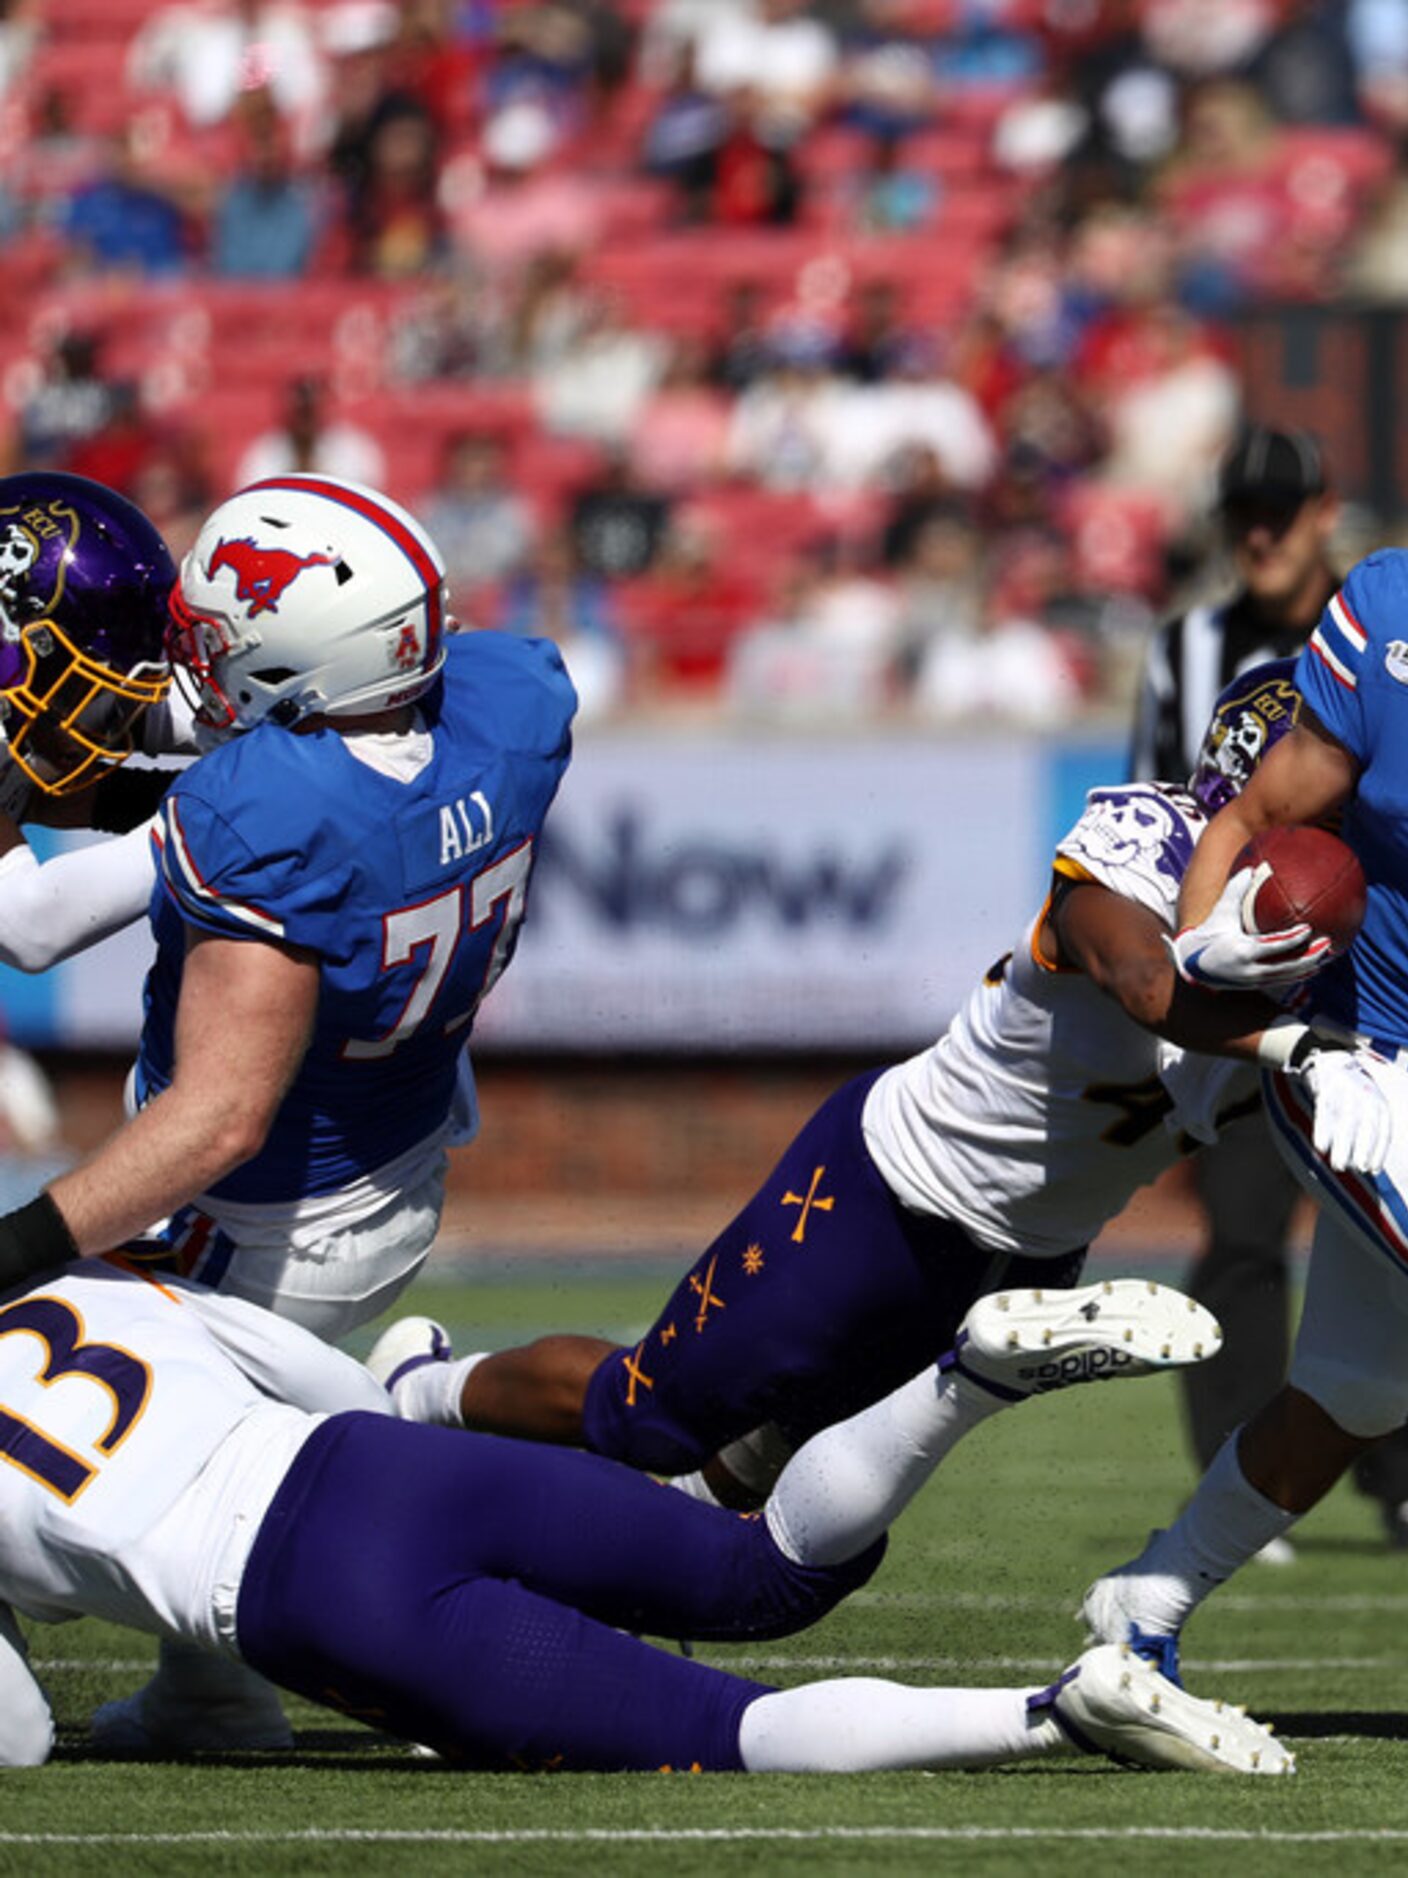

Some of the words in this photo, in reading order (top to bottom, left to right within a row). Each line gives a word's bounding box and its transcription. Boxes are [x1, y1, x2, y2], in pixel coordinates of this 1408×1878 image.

[22, 508, 63, 540] ECU
[1253, 692, 1287, 721] ECU
[439, 791, 493, 866] ALI
[338, 834, 534, 1060] 77
[1016, 1346, 1131, 1380] adidas
